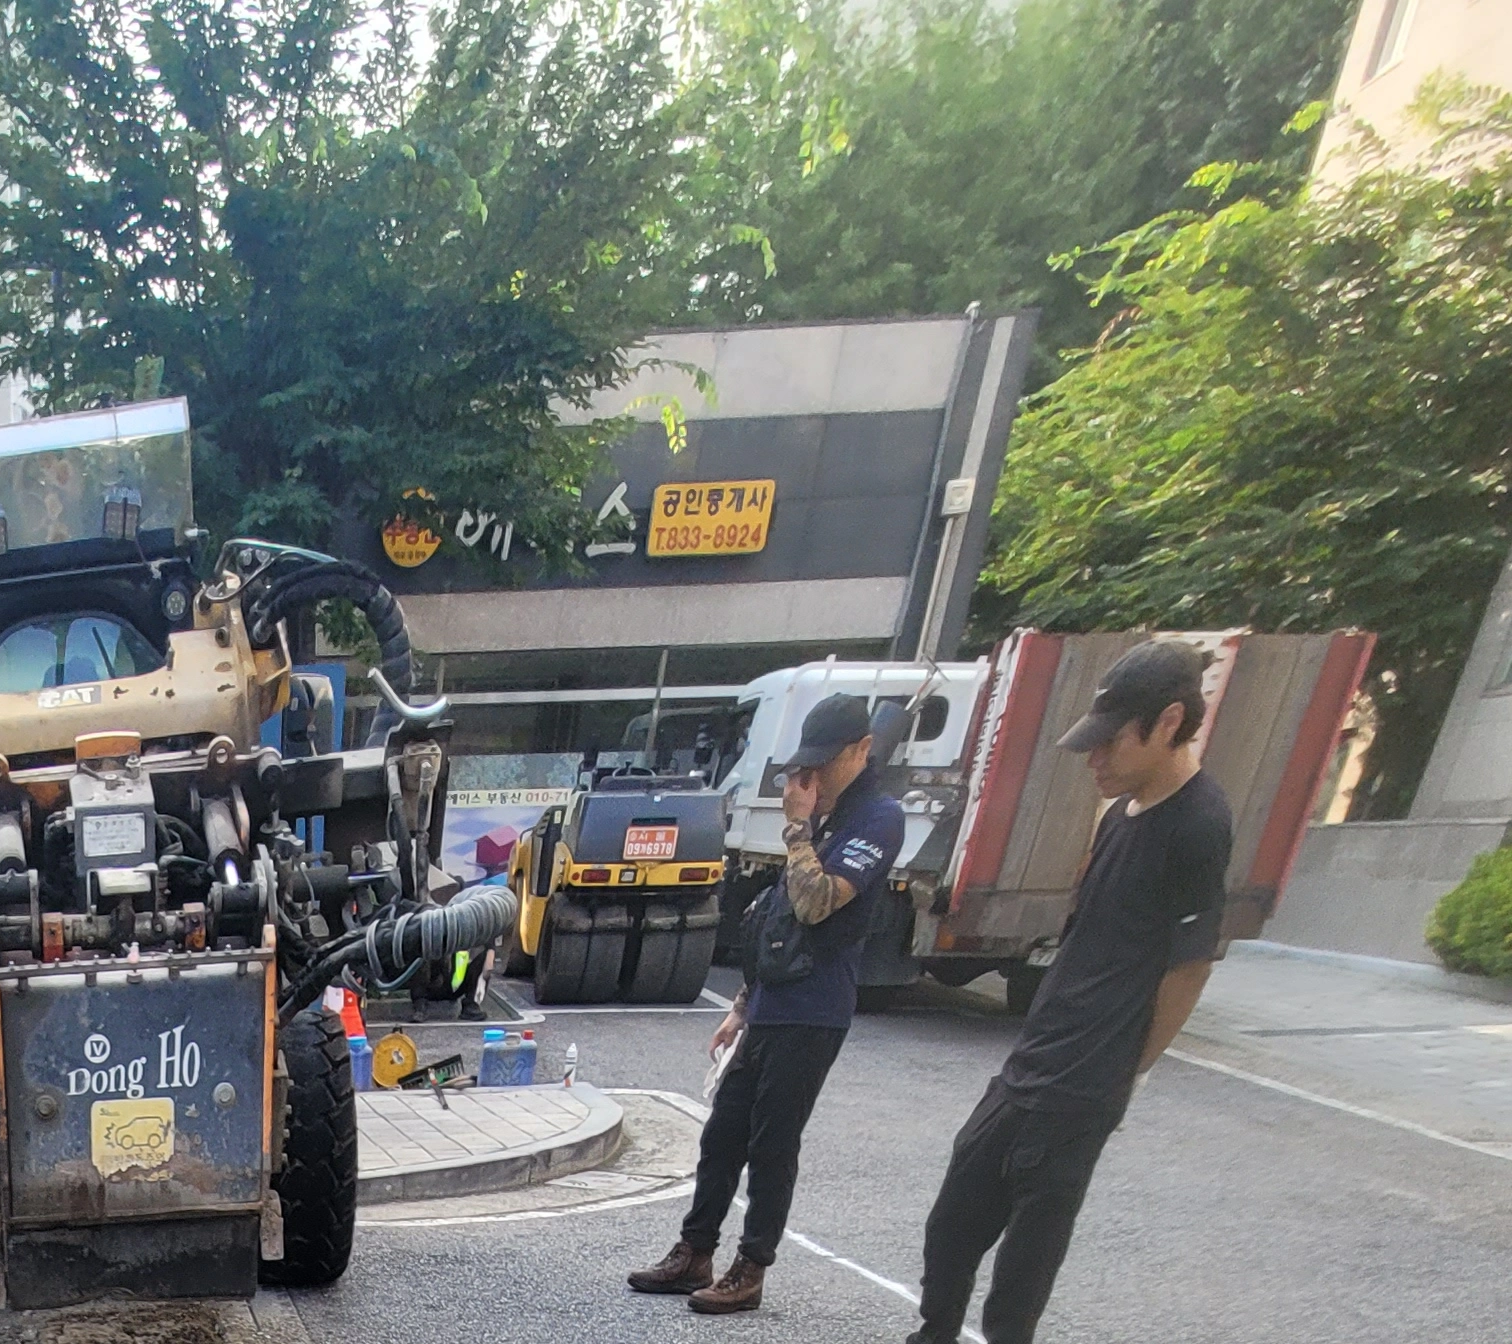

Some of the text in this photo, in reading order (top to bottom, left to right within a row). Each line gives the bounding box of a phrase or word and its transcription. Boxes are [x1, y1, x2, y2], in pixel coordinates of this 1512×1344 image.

[663, 487, 768, 517] 공인중개사
[655, 523, 762, 550] T.833-8924
[38, 686, 95, 709] CAT
[487, 791, 522, 805] 부동산
[67, 1024, 201, 1099] Dong Ho
